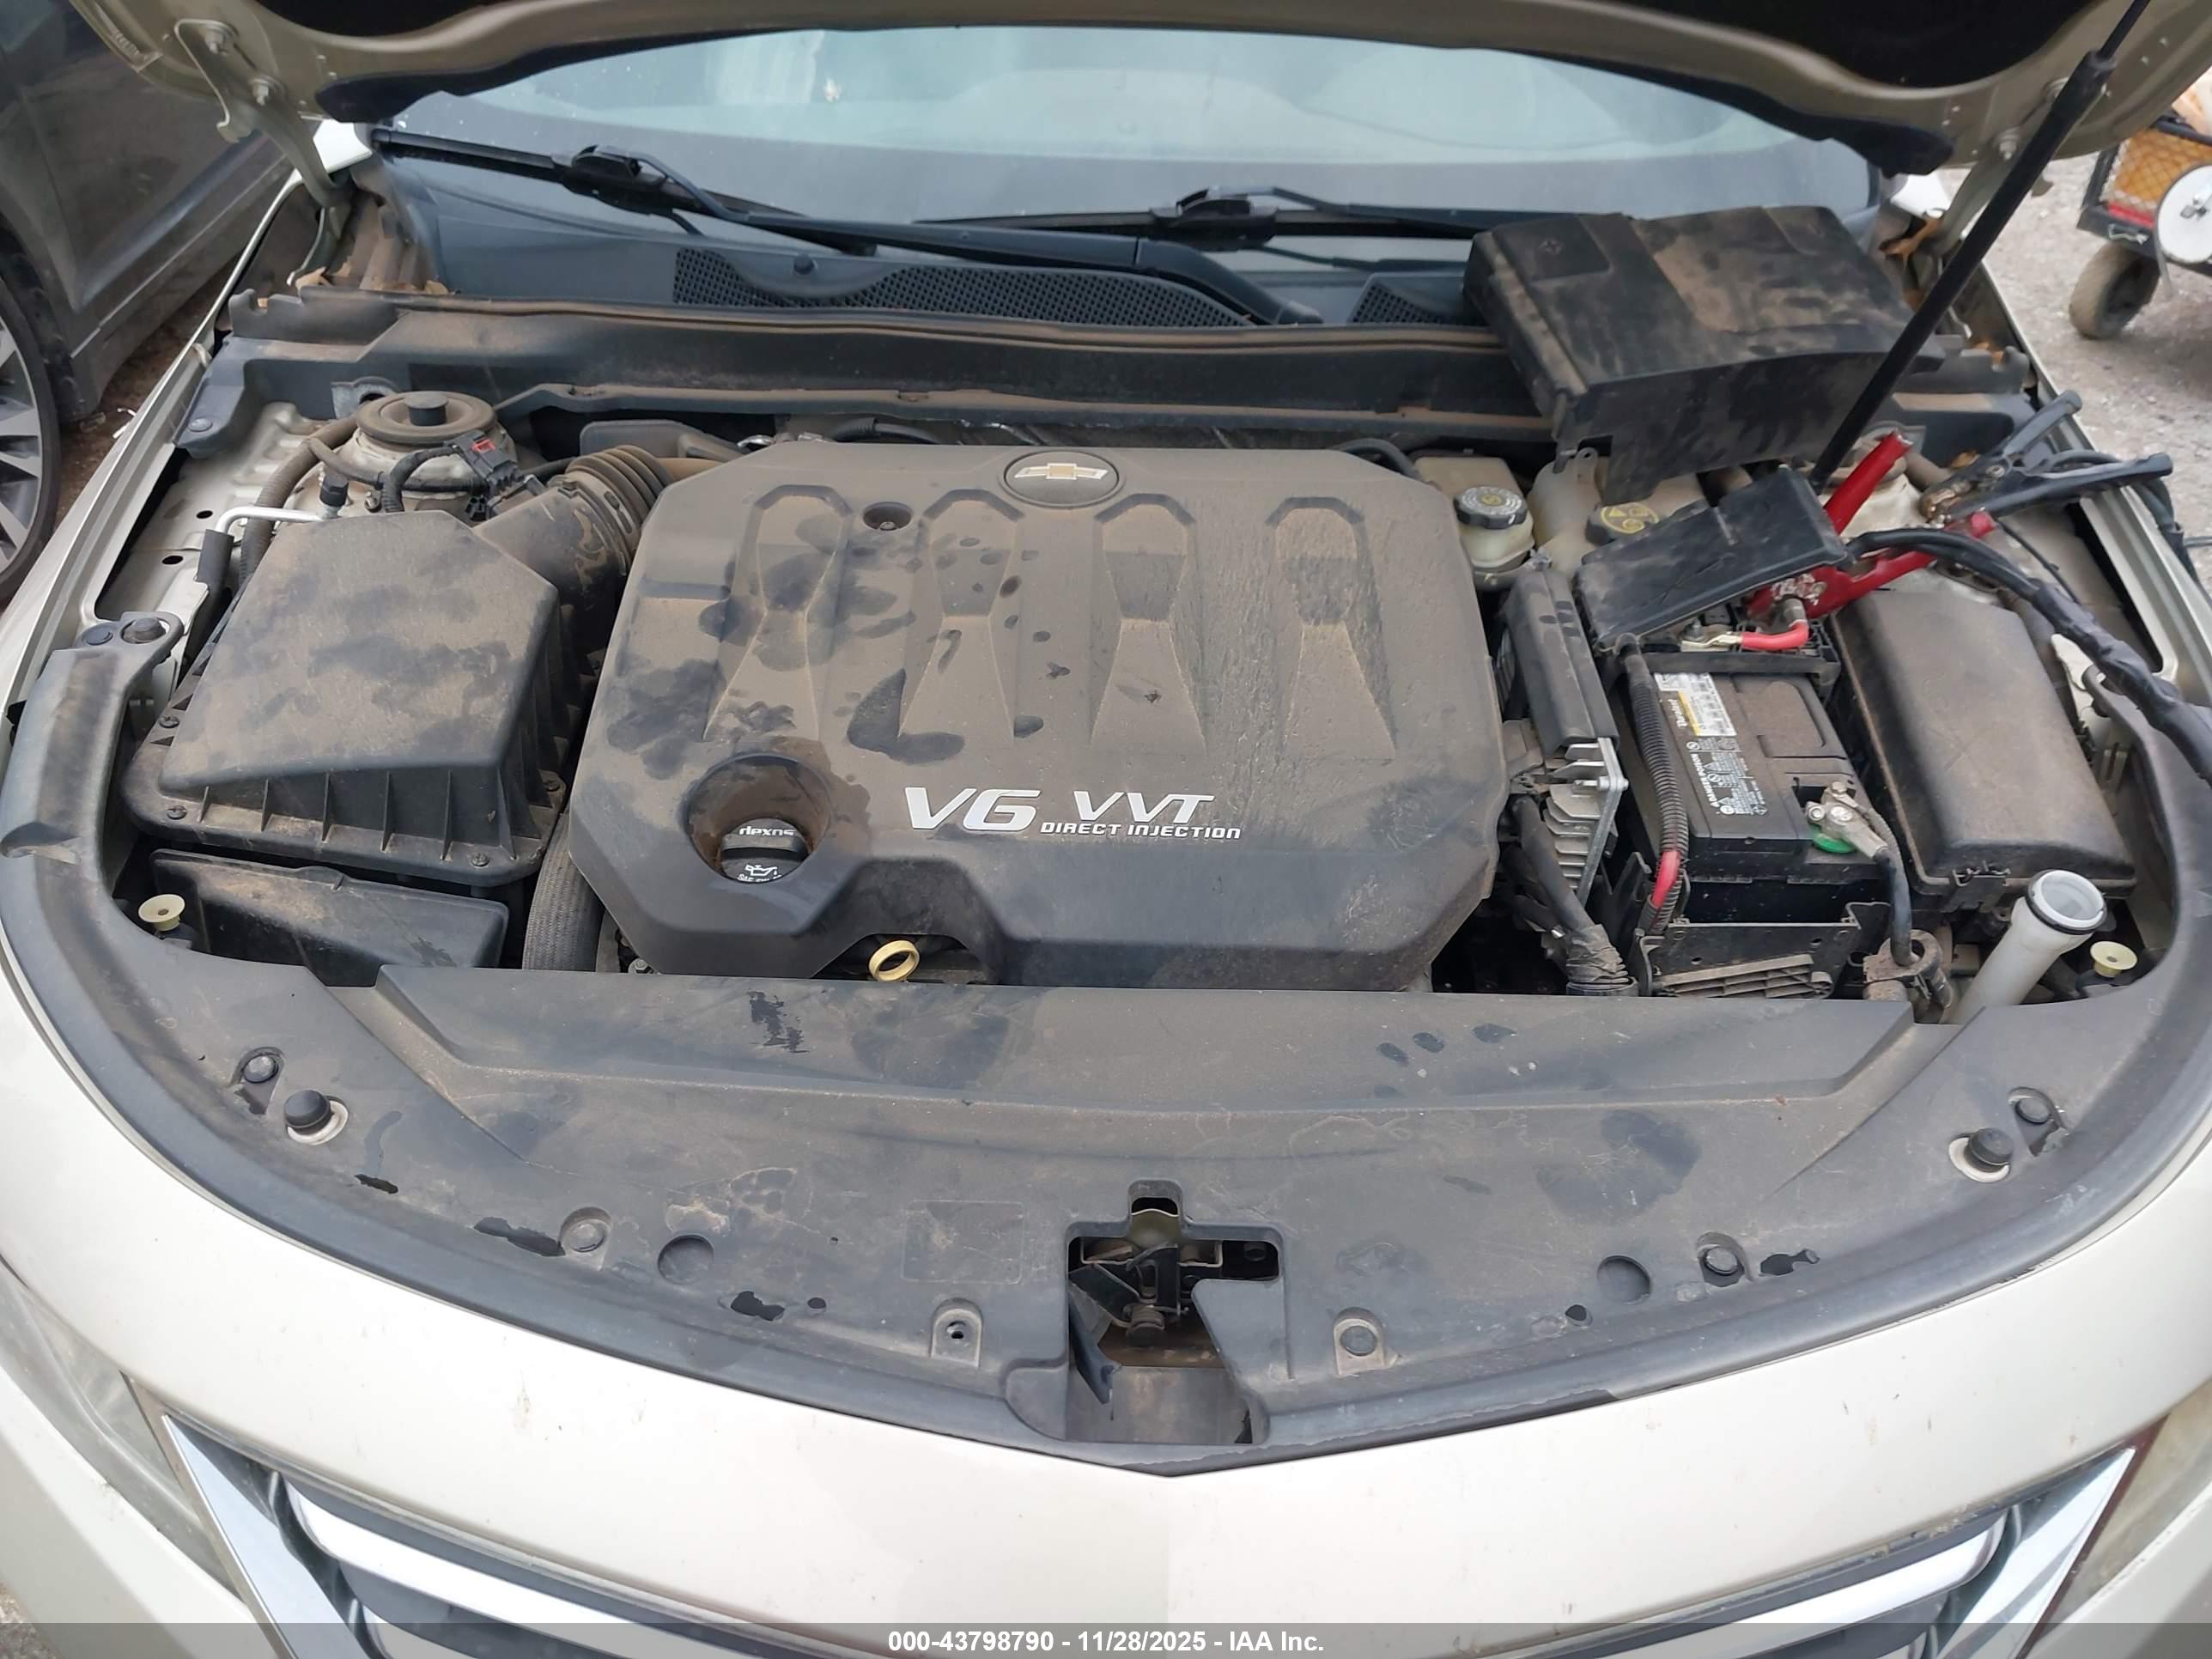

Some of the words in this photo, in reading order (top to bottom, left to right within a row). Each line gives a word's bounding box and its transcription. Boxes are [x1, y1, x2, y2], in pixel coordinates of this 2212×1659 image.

[904, 787, 1041, 831] V6
[1073, 791, 1214, 823] VVT
[1040, 822, 1120, 836] DIRECT
[1127, 824, 1242, 839] INJECTION
